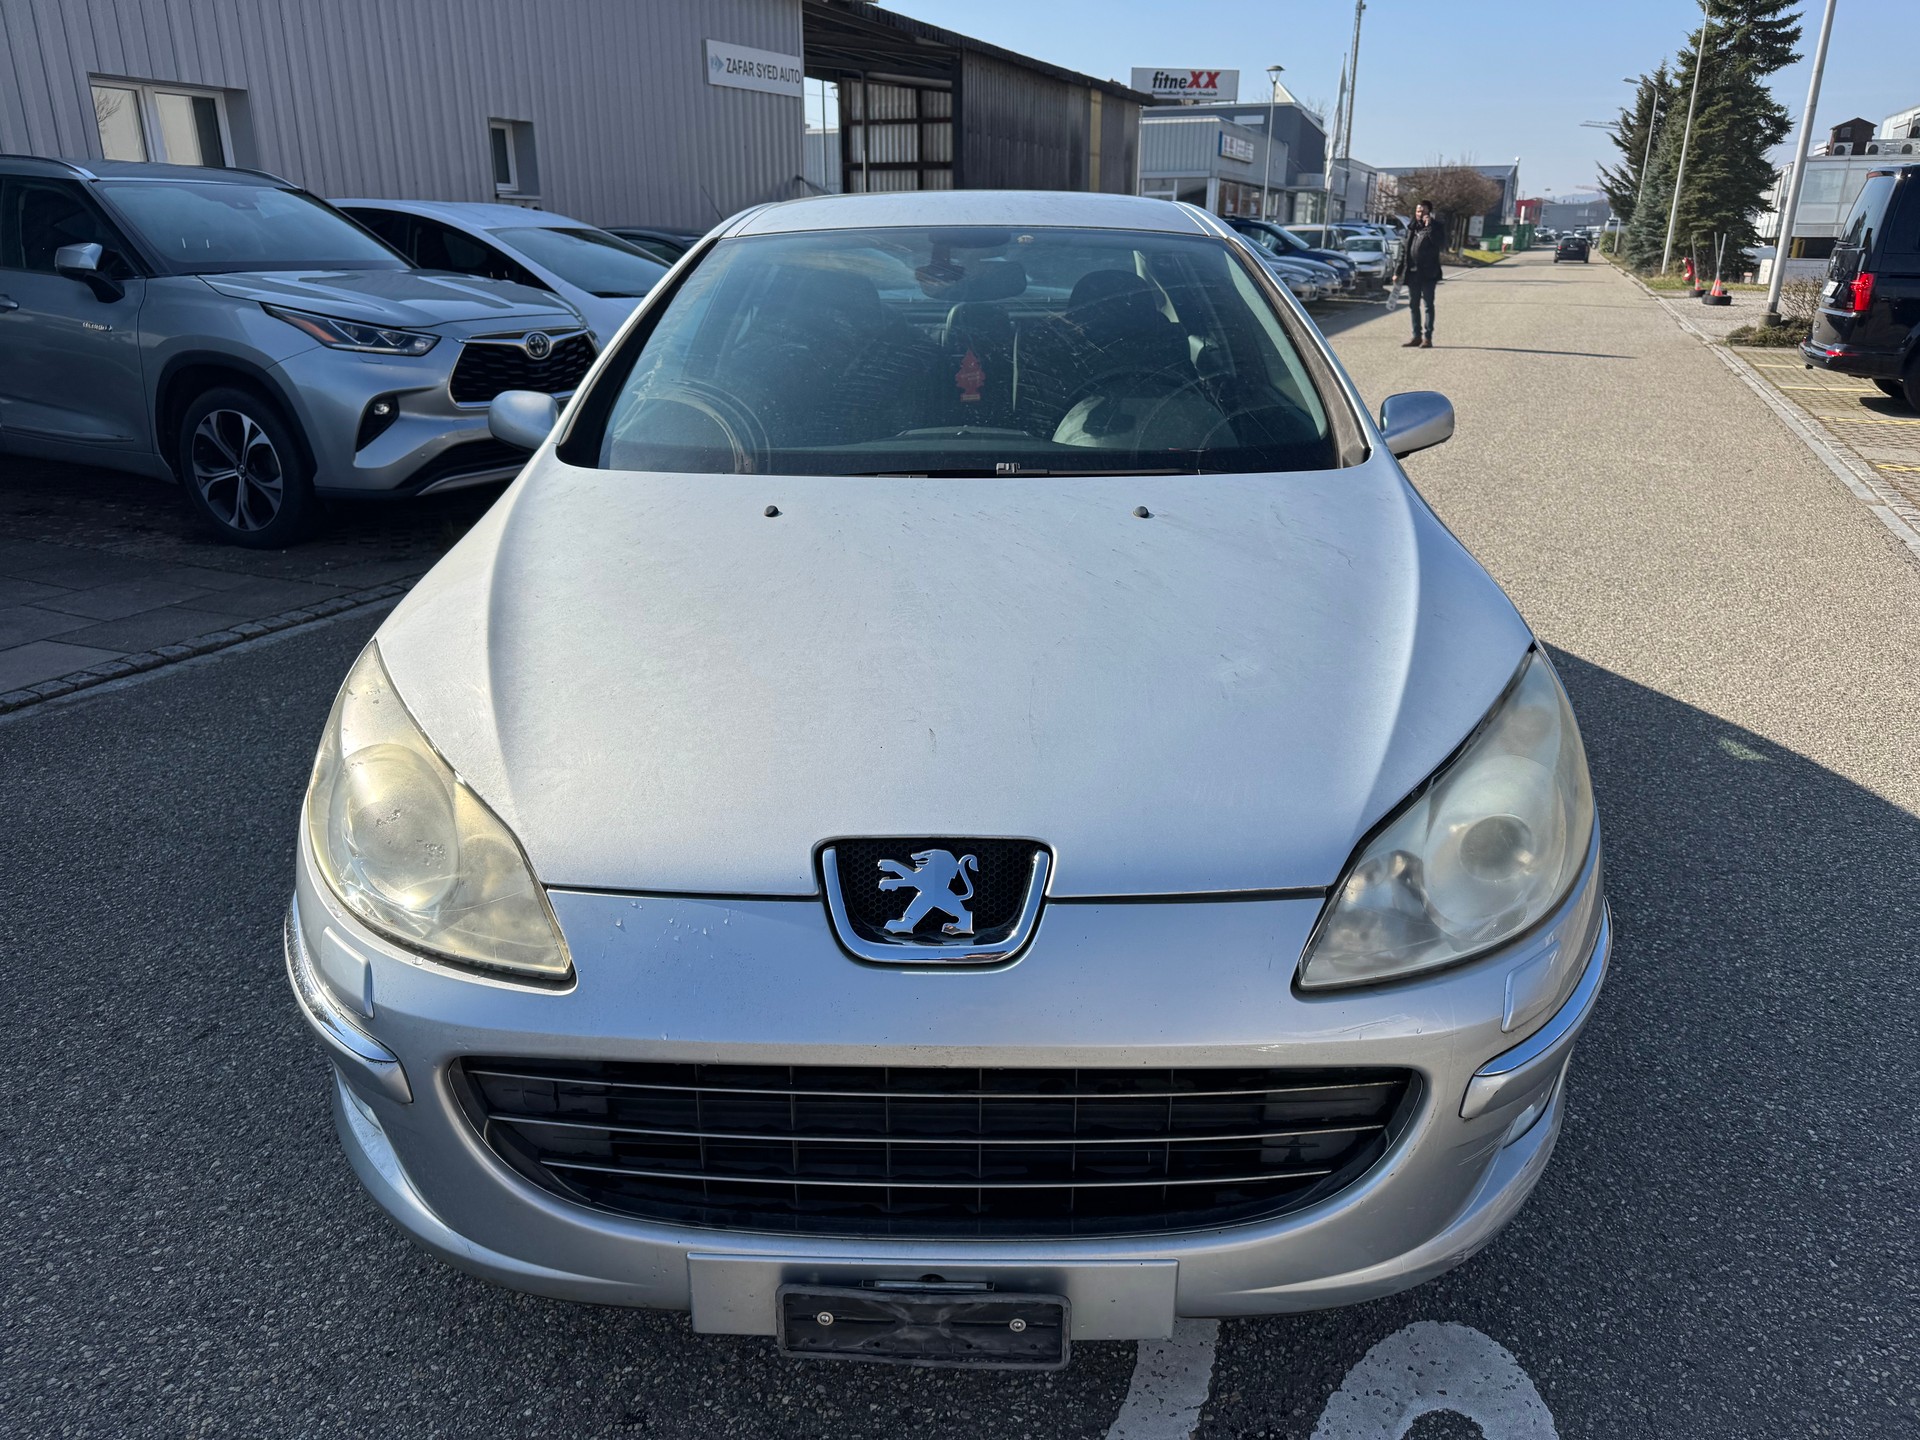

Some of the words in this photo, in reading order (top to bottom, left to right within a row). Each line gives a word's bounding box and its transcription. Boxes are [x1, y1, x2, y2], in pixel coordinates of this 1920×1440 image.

[726, 58, 755, 77] ZAFAR
[756, 63, 778, 80] SYED
[779, 66, 800, 84] AUTO
[1152, 70, 1220, 89] fitneXX
